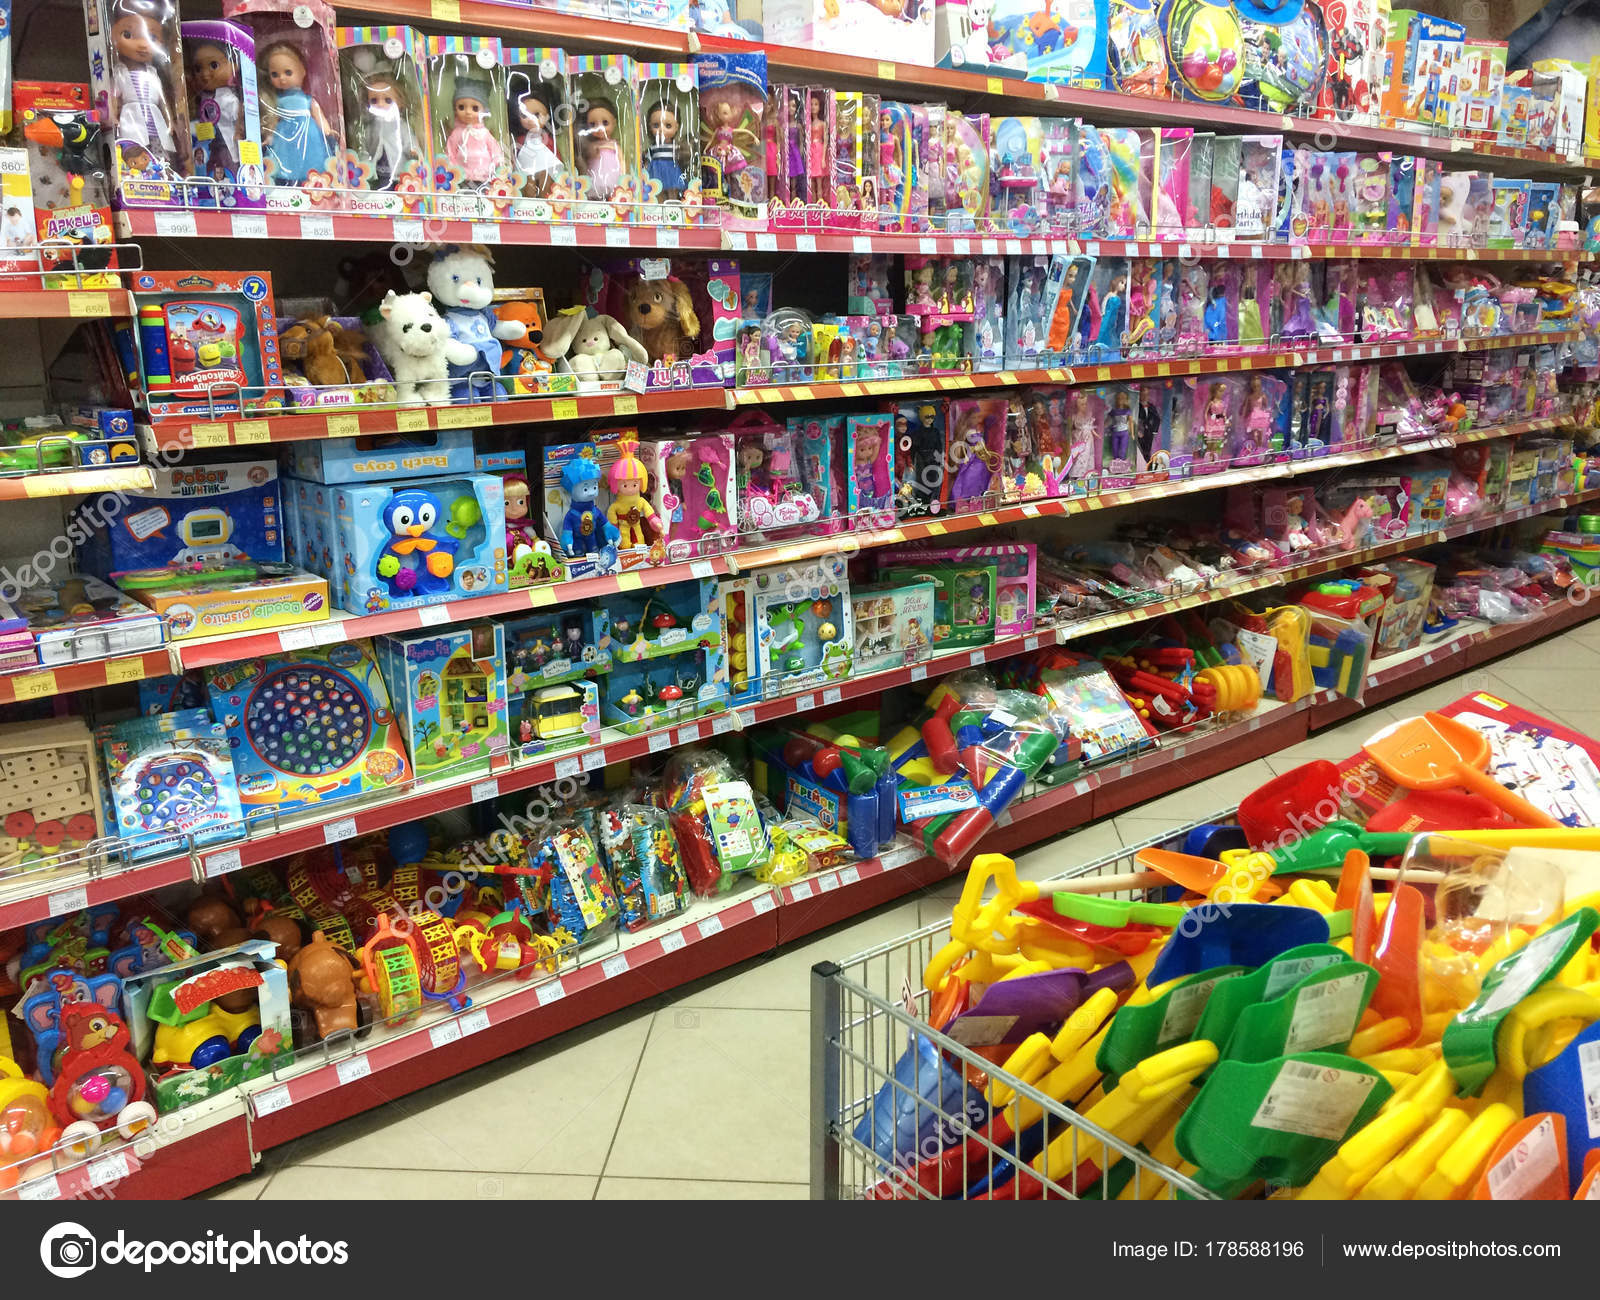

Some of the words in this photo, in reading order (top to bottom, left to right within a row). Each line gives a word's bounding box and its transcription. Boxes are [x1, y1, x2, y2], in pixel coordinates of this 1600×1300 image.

[1, 161, 21, 171] 860
[249, 282, 260, 294] 7
[323, 395, 350, 404] БАРТИ
[206, 434, 224, 444] 780
[352, 459, 398, 473] toys
[402, 455, 449, 469] Bath
[181, 484, 221, 496] ШУНТИК
[254, 601, 302, 618] Doodle
[406, 643, 434, 660] Peppa
[435, 638, 451, 656] Pig
[121, 669, 139, 680] 739
[30, 684, 49, 695] 578
[219, 861, 236, 872] 620
[64, 900, 82, 911] 988
